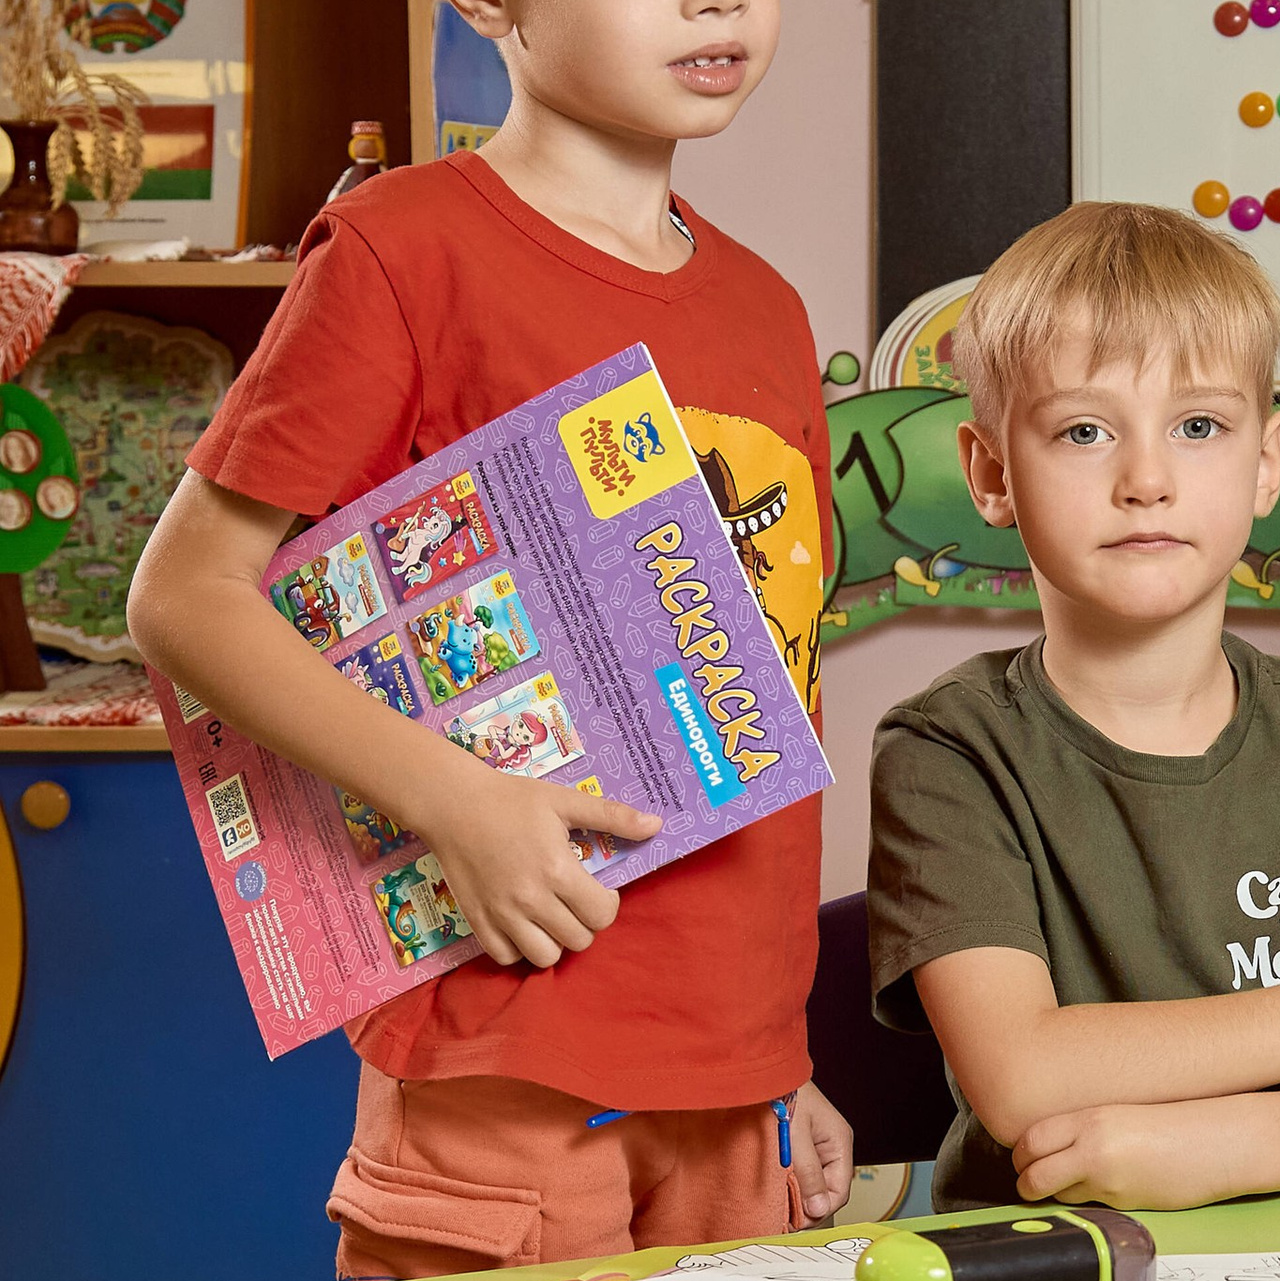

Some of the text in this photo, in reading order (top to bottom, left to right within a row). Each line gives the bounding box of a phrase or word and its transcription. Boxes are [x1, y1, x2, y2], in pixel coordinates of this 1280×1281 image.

[474, 460, 497, 502] Раскраски
[495, 511, 509, 532] этой
[835, 431, 891, 516] 1
[465, 501, 490, 550] РАСКРАСКА
[490, 451, 515, 500] маленькому
[509, 499, 532, 542] художнику
[545, 586, 577, 644] разноцветный
[570, 643, 584, 662] мир
[499, 446, 516, 474] Кроме
[518, 493, 540, 535] раскраска
[536, 534, 556, 572] вызывает
[575, 630, 606, 686] Подобранные
[609, 706, 638, 758] обязательно
[518, 436, 541, 477] Раскраска
[538, 482, 566, 538] незаменимый
[561, 538, 584, 581] помощник
[600, 634, 624, 673] развитии
[633, 707, 667, 772] Раскрашивание
[391, 662, 414, 712] РАСКРАСКА
[562, 568, 589, 621] способствует
[628, 726, 655, 773] восприятия
[630, 518, 785, 786] РАСКРАСКА
[664, 676, 728, 789] Единороги
[267, 898, 285, 933] Покупая
[279, 934, 290, 949] эту
[272, 969, 284, 991] стать
[284, 1003, 294, 1019] шаг
